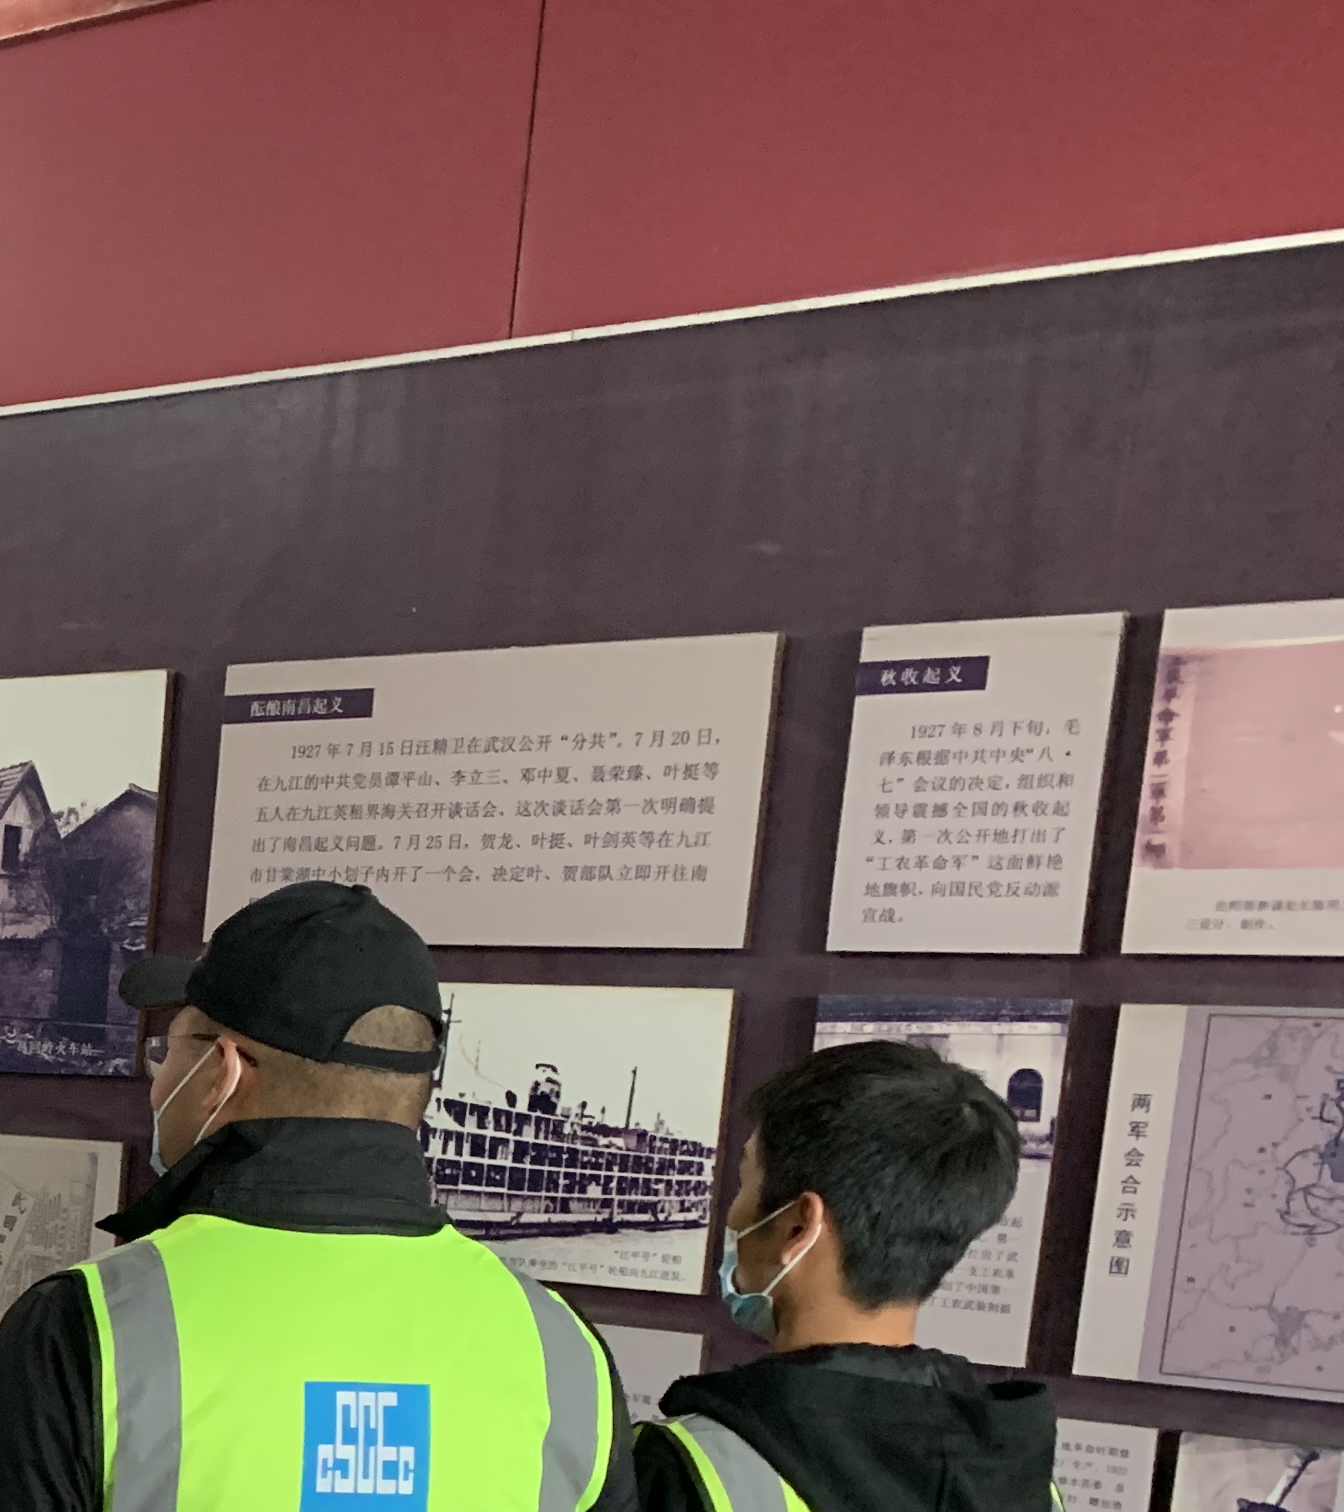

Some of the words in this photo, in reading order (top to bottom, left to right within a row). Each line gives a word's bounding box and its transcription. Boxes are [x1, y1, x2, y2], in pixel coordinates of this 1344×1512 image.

[880, 666, 963, 687] 秋收起义
[250, 696, 344, 717] 酝酿南昌起义
[874, 800, 1071, 820] 领导震撼全国的秋收起
[862, 907, 905, 924] 宣战。
[1108, 1092, 1153, 1276] 两军会合示意图
